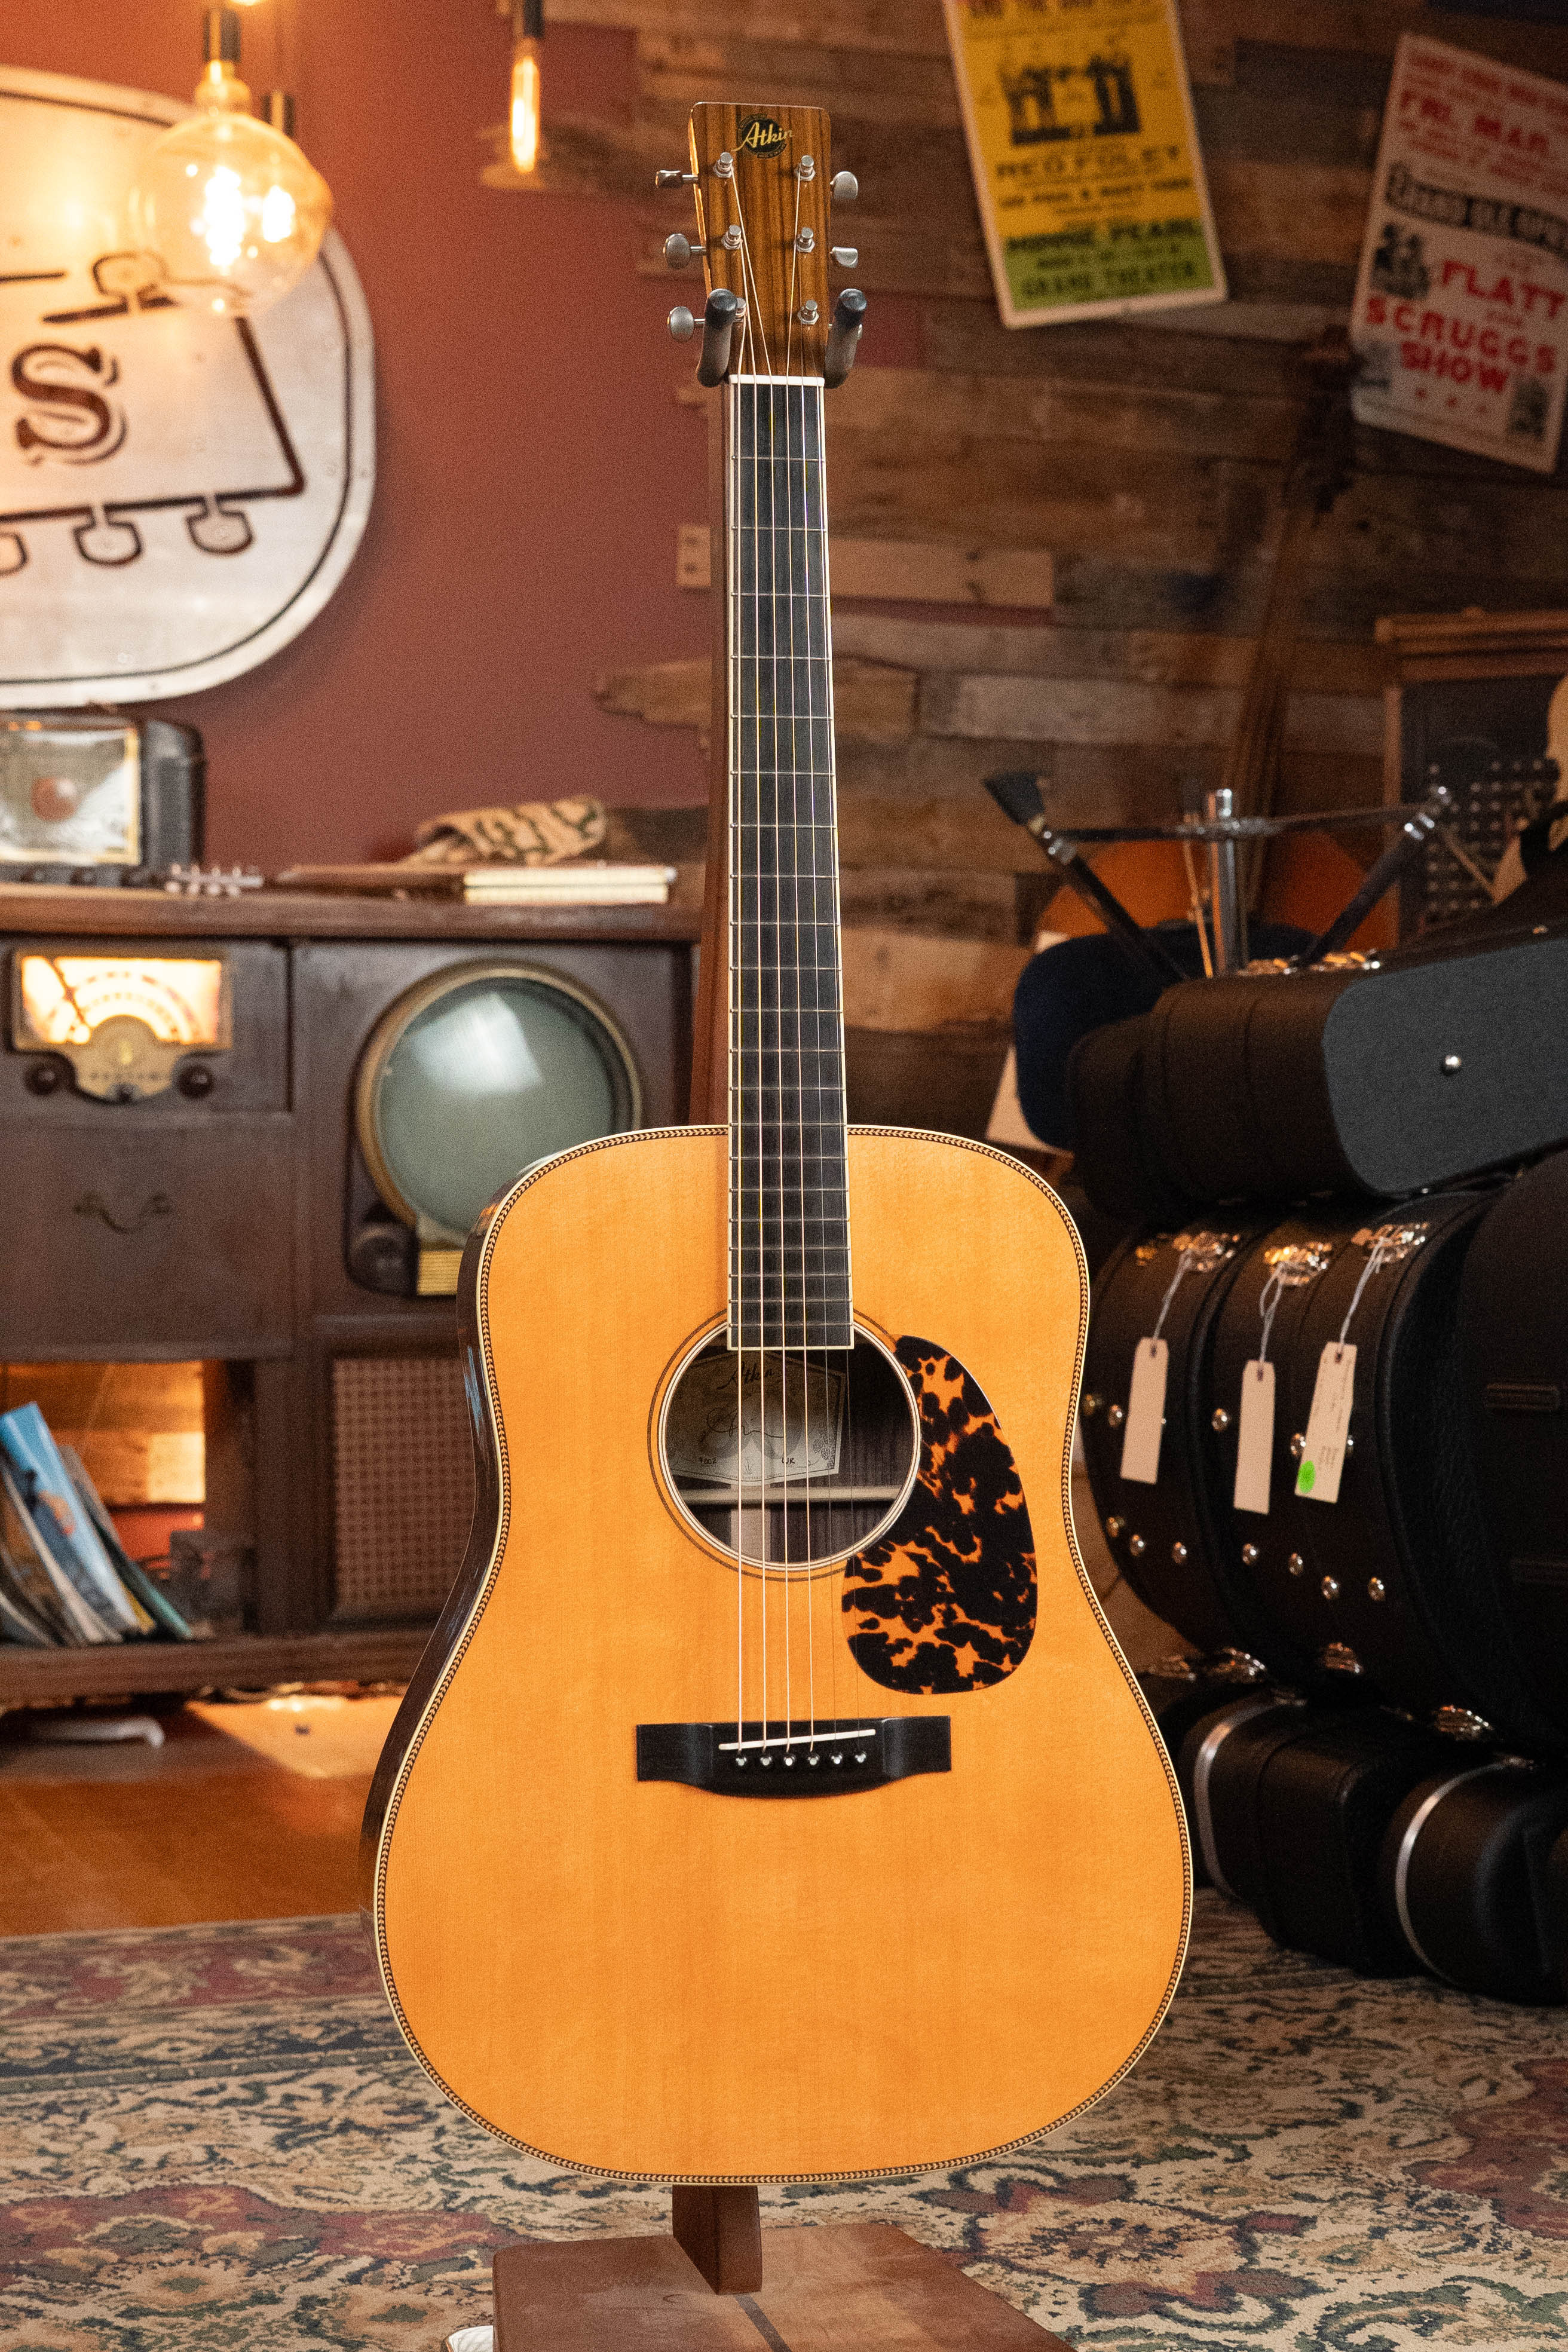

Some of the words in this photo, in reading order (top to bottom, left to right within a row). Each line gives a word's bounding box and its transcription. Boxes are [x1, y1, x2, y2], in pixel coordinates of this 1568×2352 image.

[731, 121, 794, 152] Atkin
[1441, 260, 1566, 320] FLATT
[1366, 298, 1555, 374] SCRUGGS
[1400, 341, 1510, 395] SHOW
